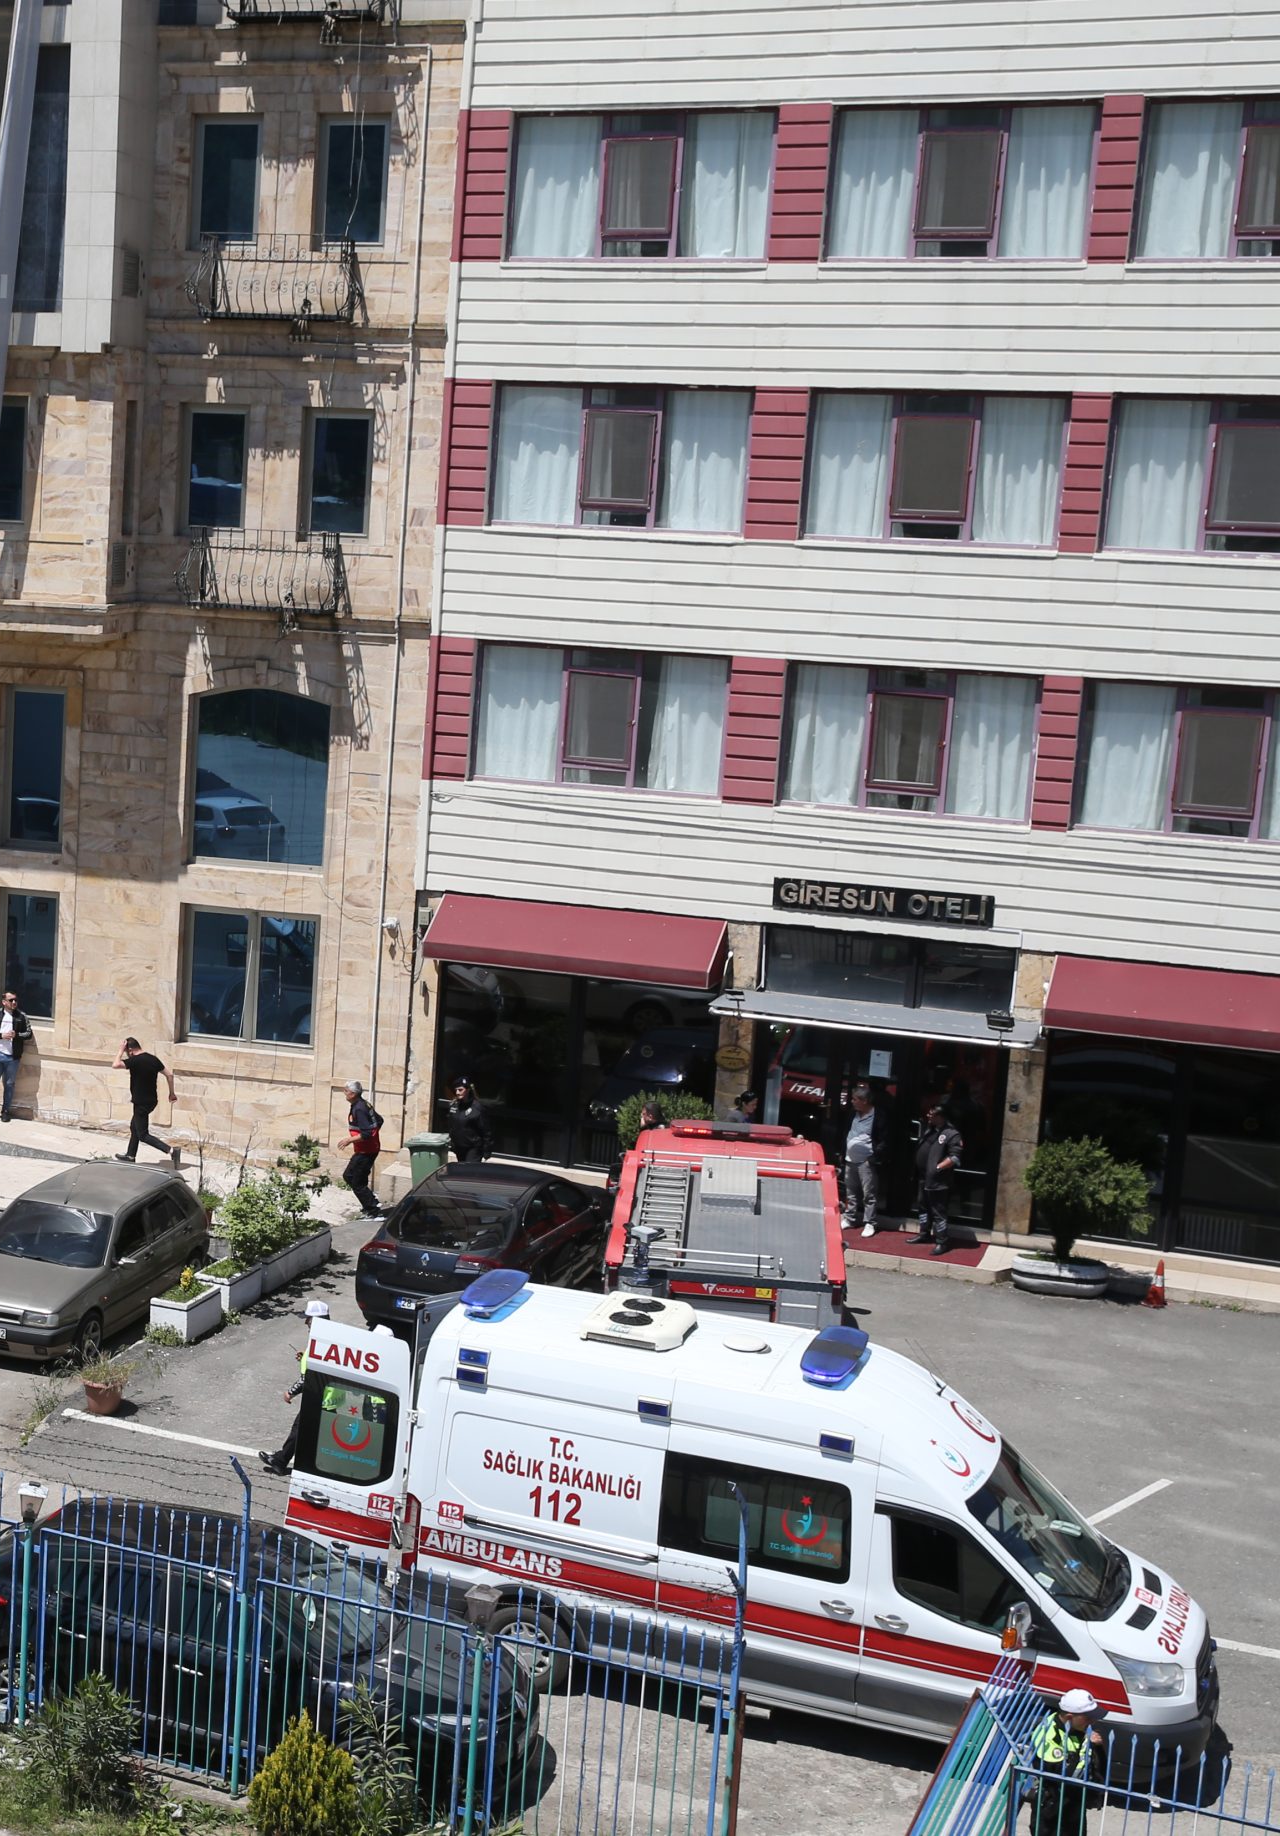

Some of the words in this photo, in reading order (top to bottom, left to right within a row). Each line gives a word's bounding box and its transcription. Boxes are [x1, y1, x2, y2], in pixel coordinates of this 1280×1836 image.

[779, 880, 895, 913] GİRESUN
[907, 893, 988, 921] OTELİ
[308, 1338, 380, 1373] LANS
[549, 1436, 579, 1462] T.C.
[483, 1449, 545, 1481] SAĞLIK
[549, 1463, 642, 1501] BAKANLIĞI
[372, 1495, 390, 1510] 112
[442, 1503, 460, 1518] 112
[529, 1485, 583, 1527] 112
[424, 1529, 563, 1578] AMBULANS
